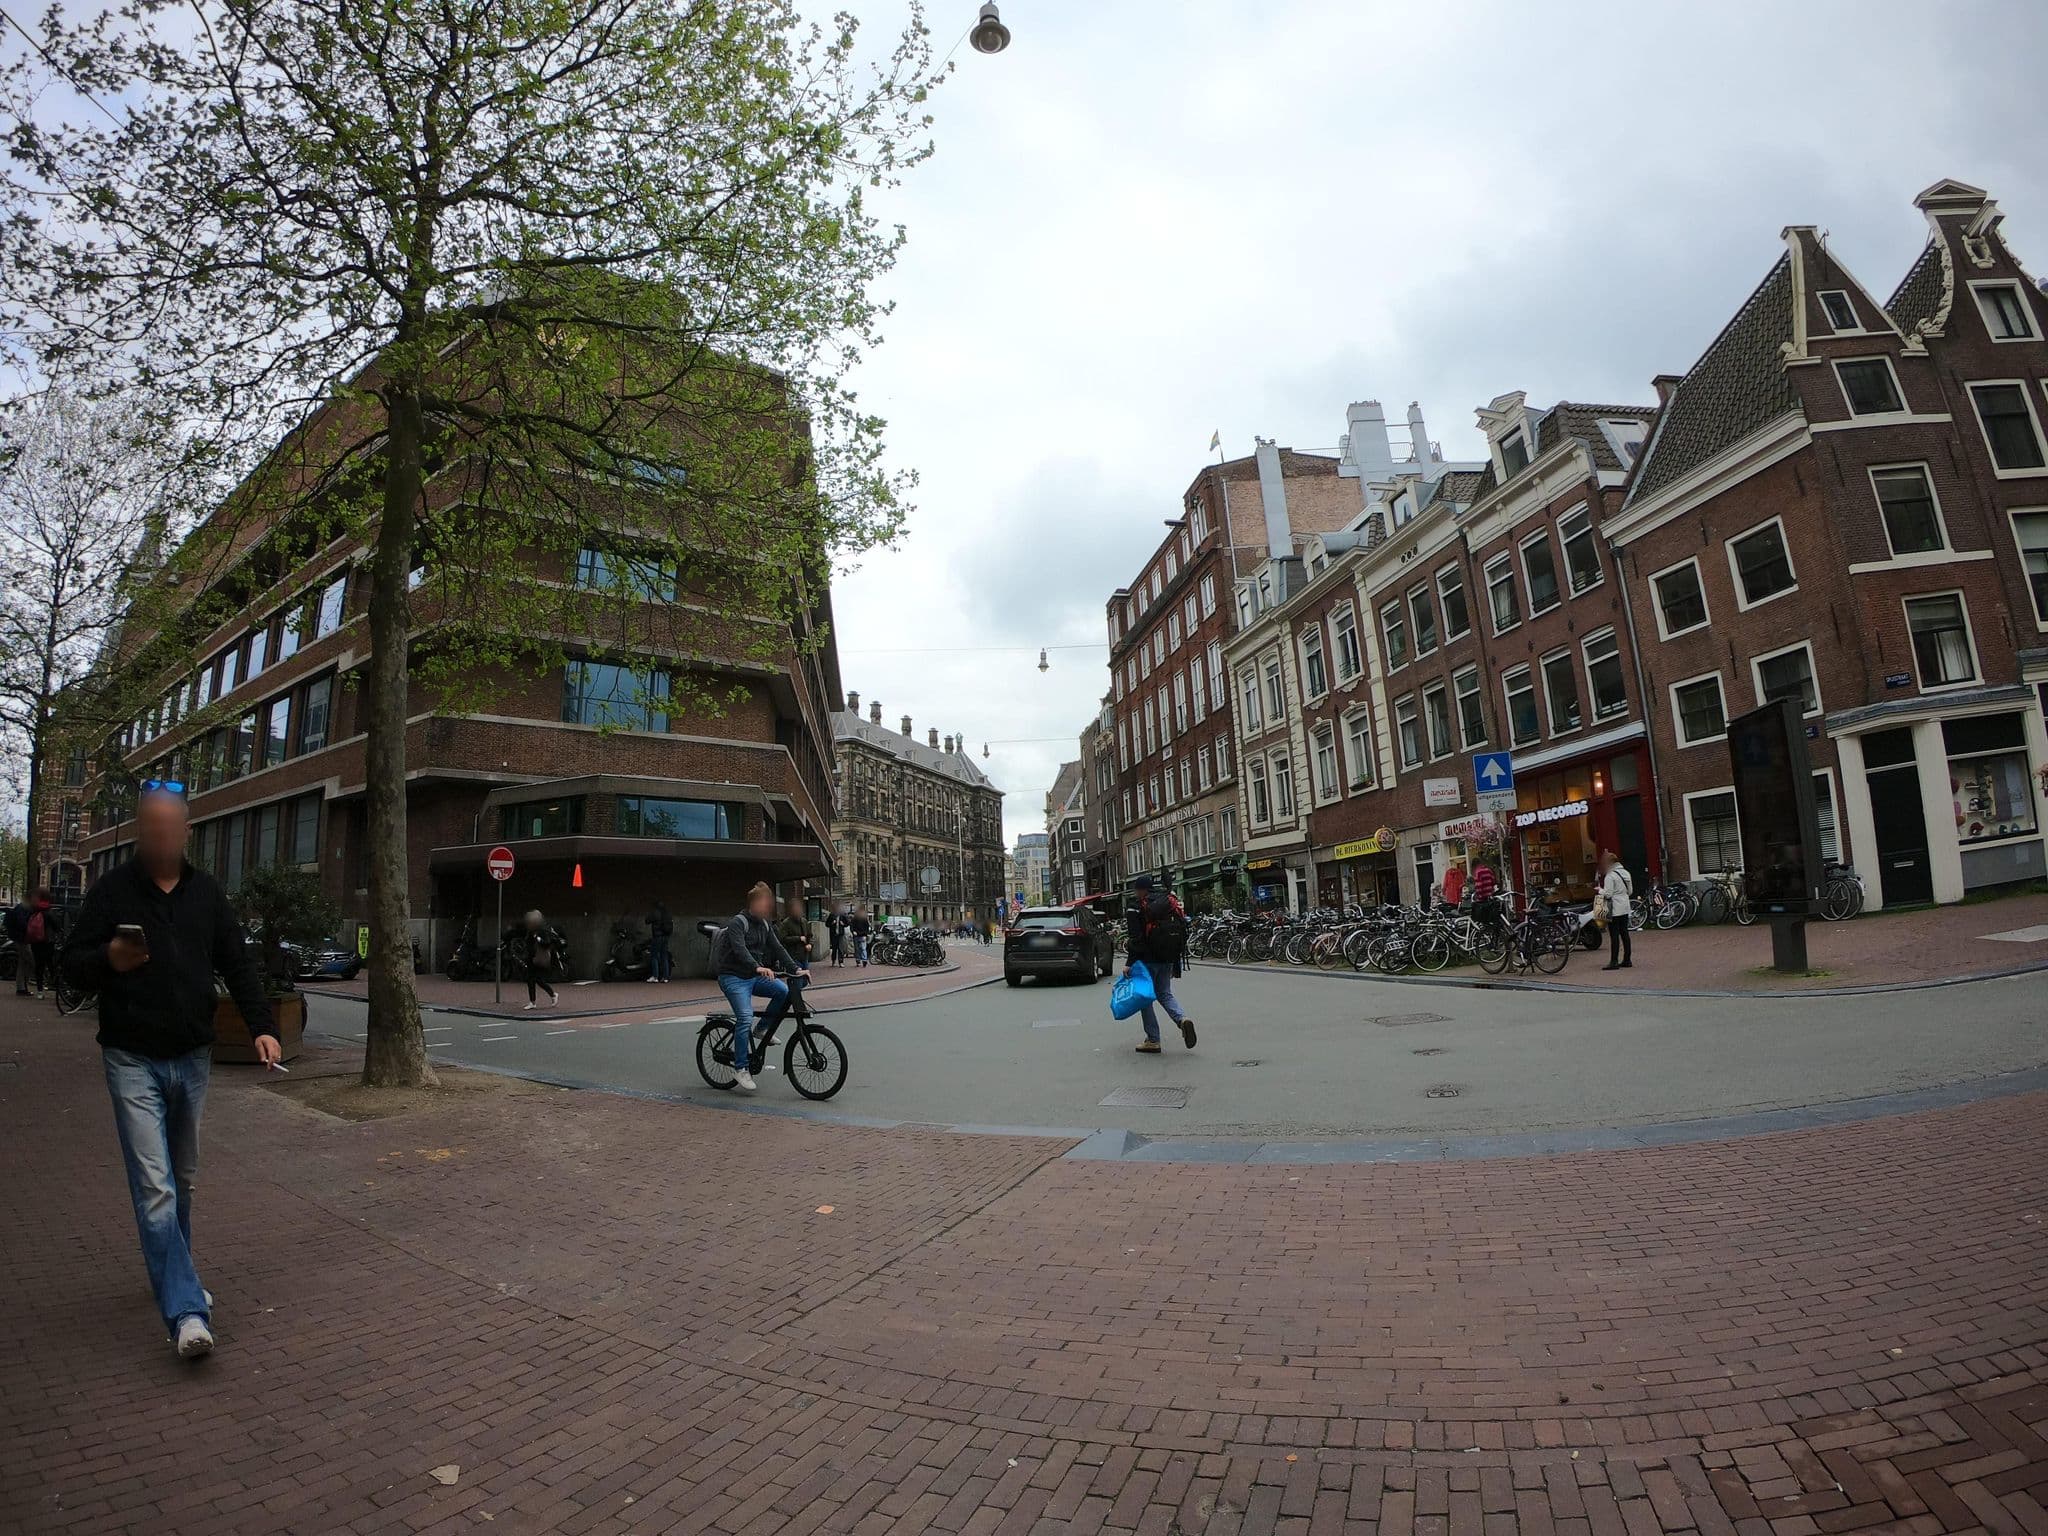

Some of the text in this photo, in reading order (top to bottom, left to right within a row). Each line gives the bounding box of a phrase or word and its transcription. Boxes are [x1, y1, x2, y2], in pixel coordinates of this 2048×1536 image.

[111, 782, 127, 796] W
[1478, 791, 1514, 800] uitgezonderd
[1515, 800, 1589, 827] ZAP RECORDS
[1345, 840, 1376, 855] BIERKONIN
